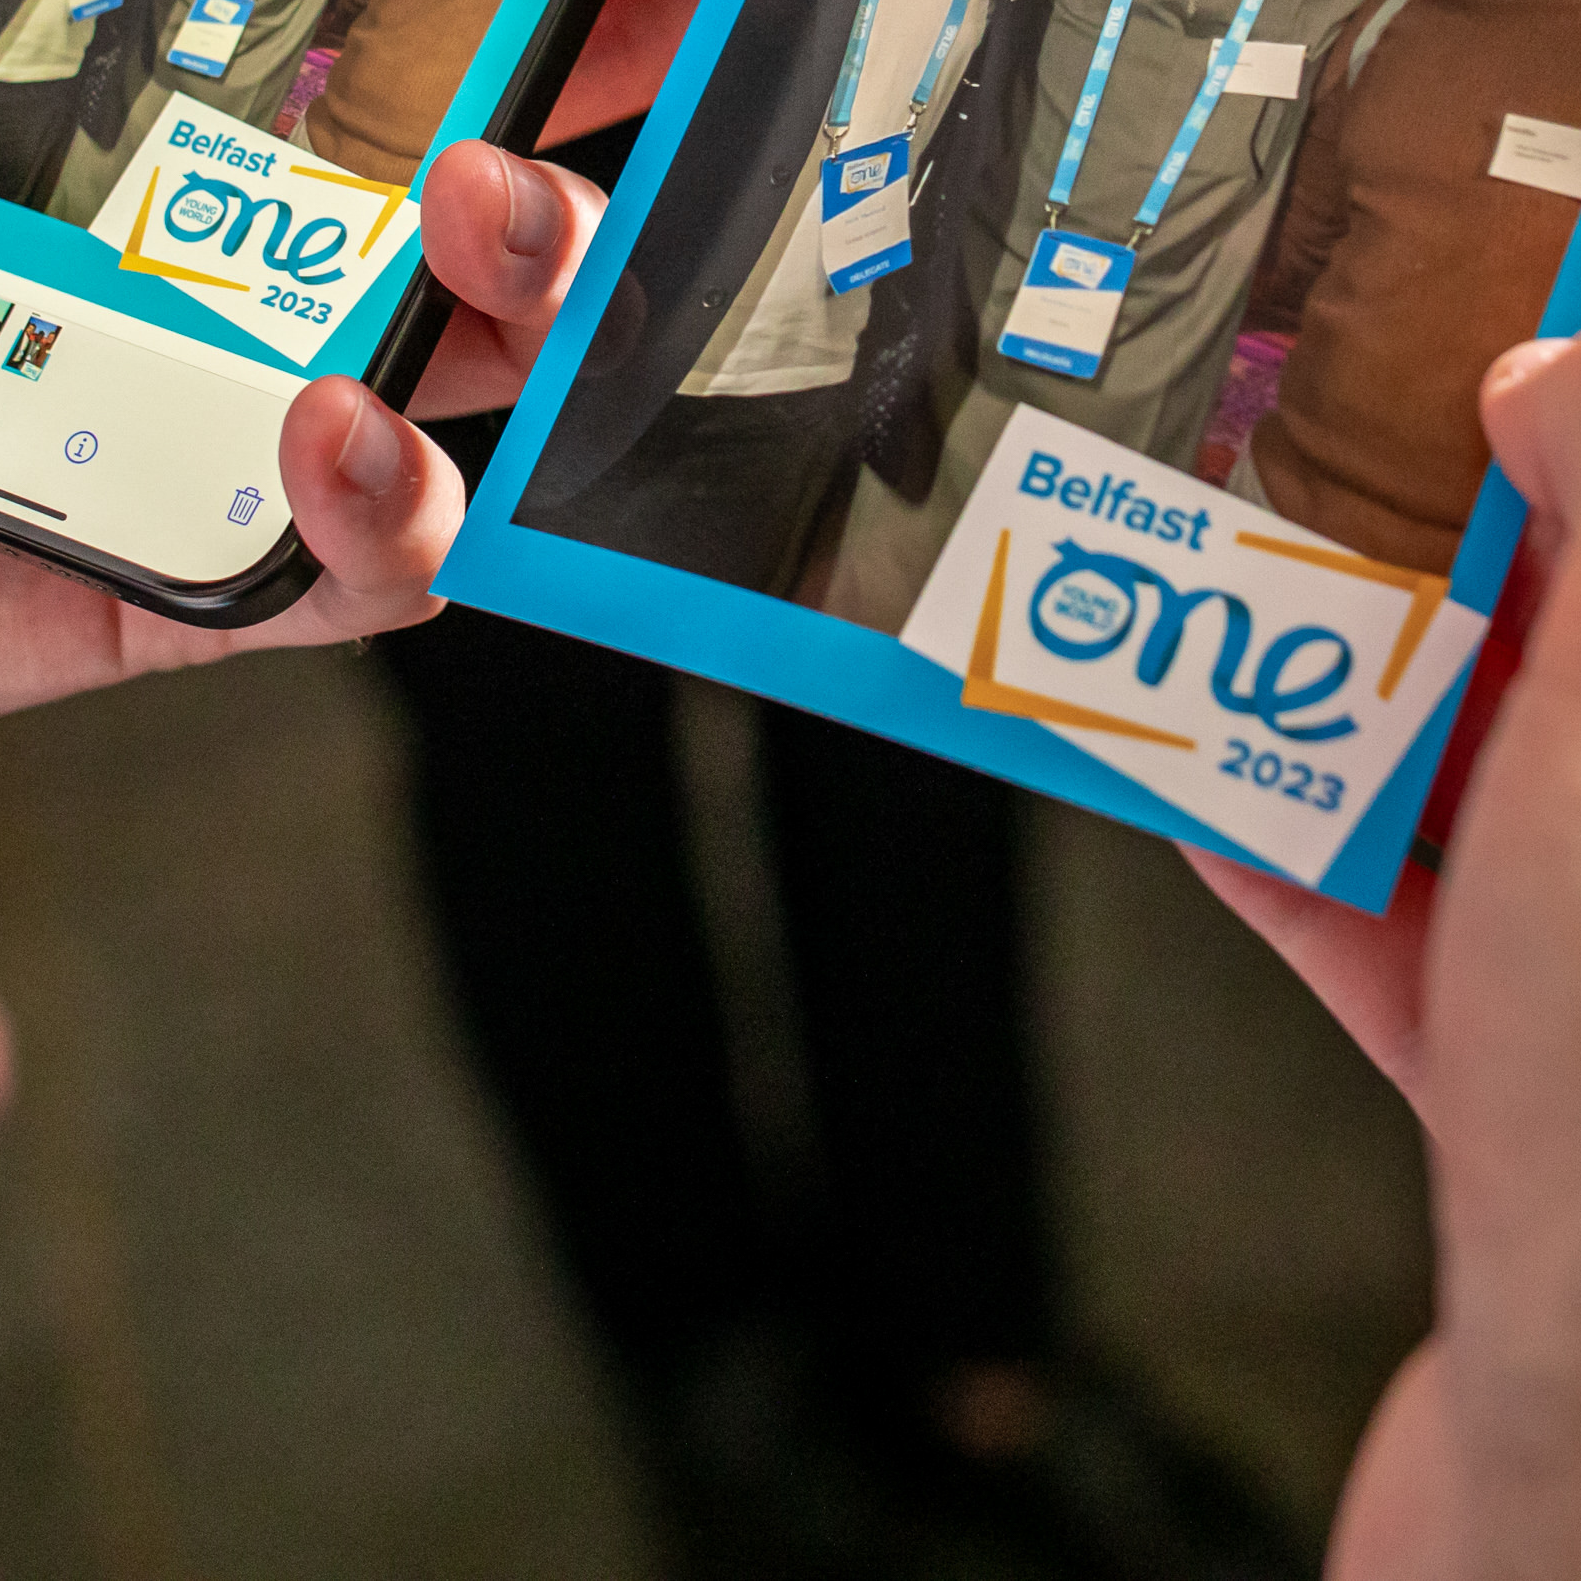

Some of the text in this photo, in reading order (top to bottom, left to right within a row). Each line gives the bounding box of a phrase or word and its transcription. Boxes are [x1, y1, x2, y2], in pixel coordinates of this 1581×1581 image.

[167, 119, 277, 177] Belfast
[179, 207, 214, 226] WORLD
[185, 197, 218, 216] YOUNG
[260, 285, 333, 324] 2023
[1018, 450, 1211, 552] Belfast
[1217, 738, 1347, 814] 2023
